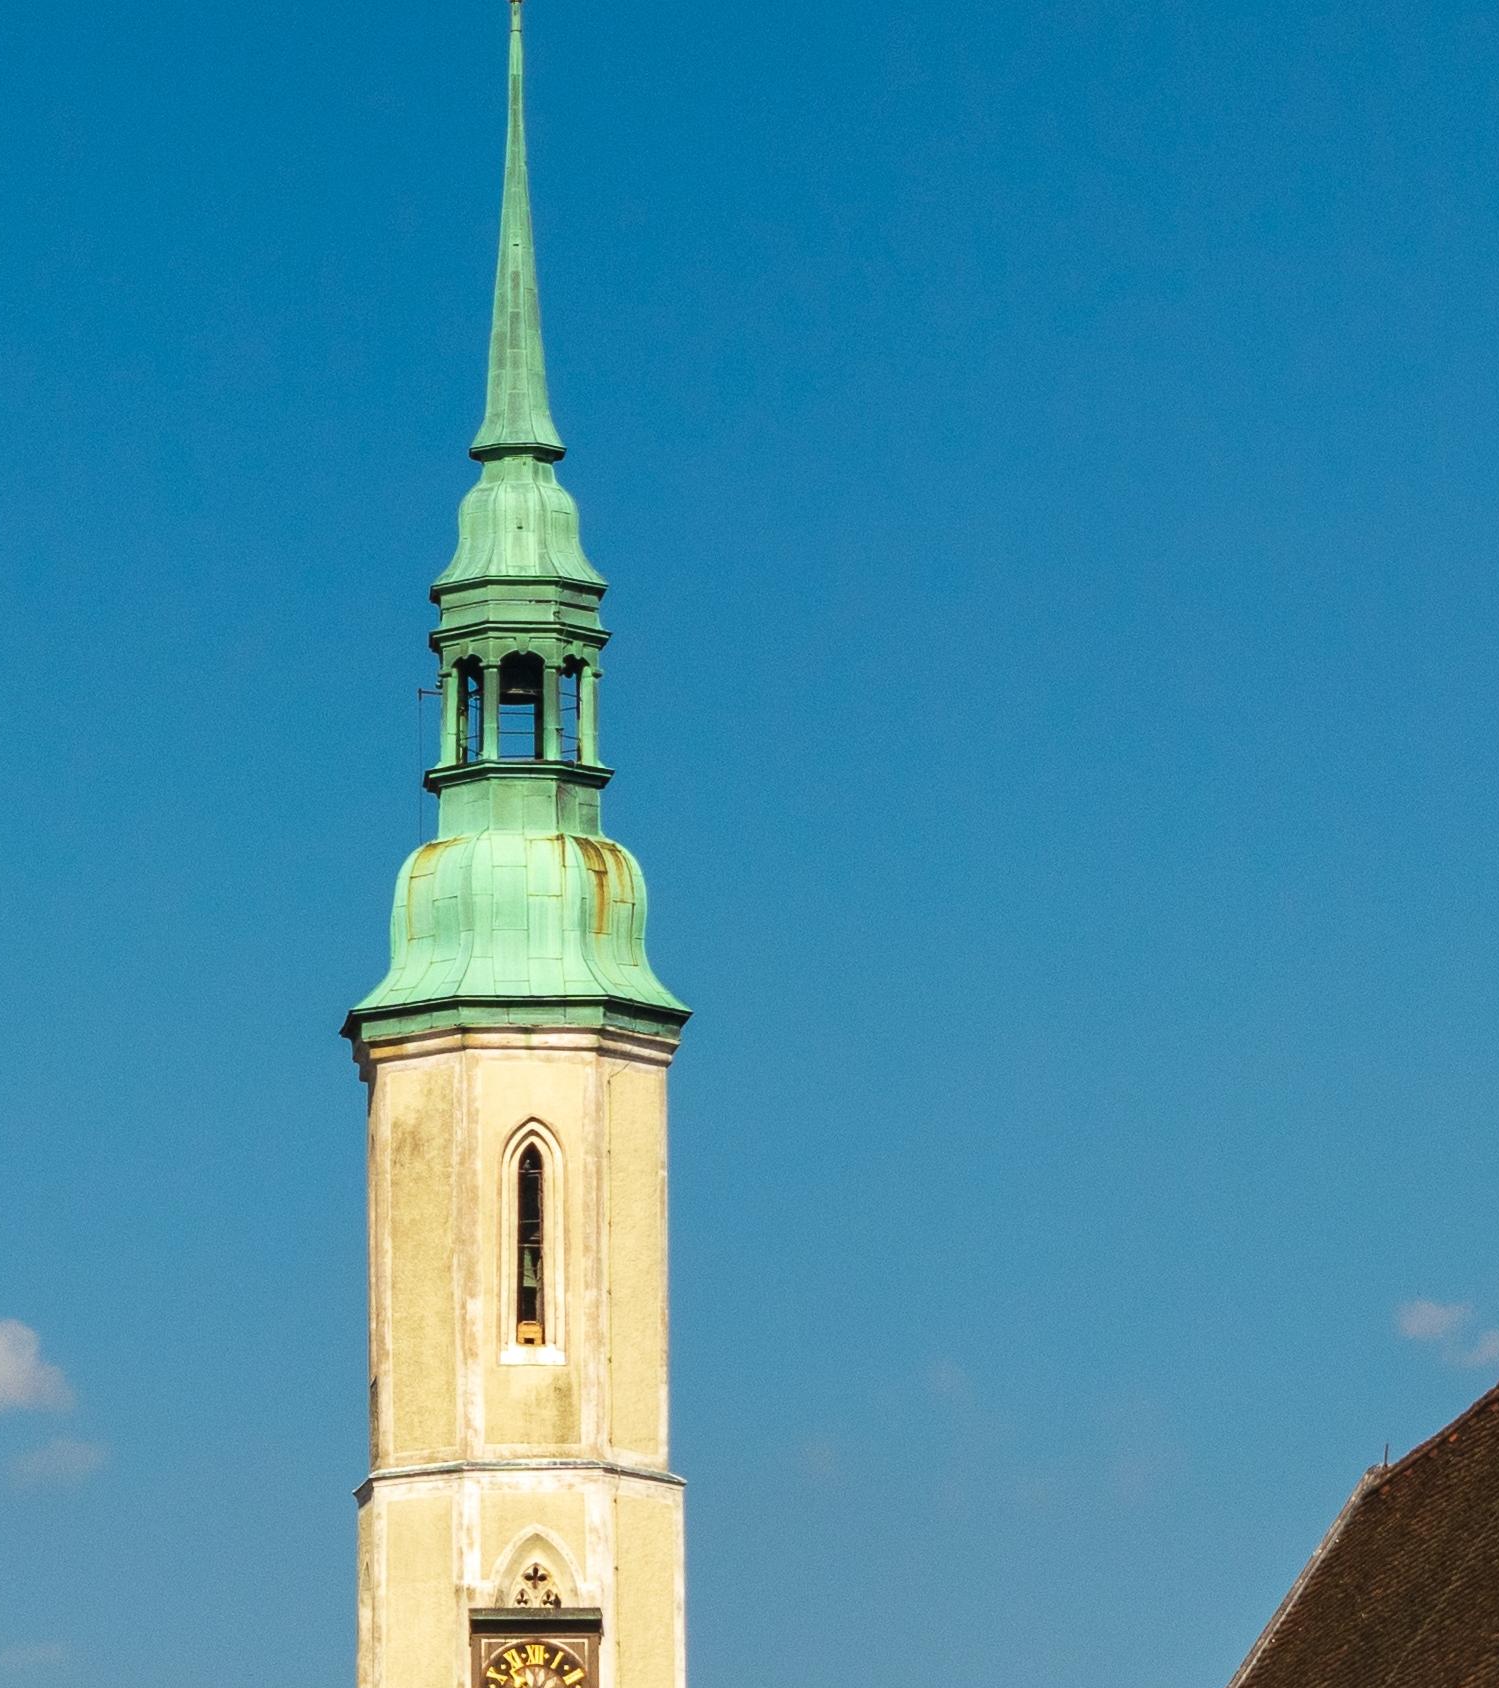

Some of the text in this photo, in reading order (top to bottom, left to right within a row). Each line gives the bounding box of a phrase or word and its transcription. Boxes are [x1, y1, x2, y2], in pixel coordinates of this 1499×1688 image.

[525, 1645, 545, 1665] XII
[550, 1651, 564, 1669] I
[486, 1667, 508, 1685] X
[563, 1668, 584, 1685] II
